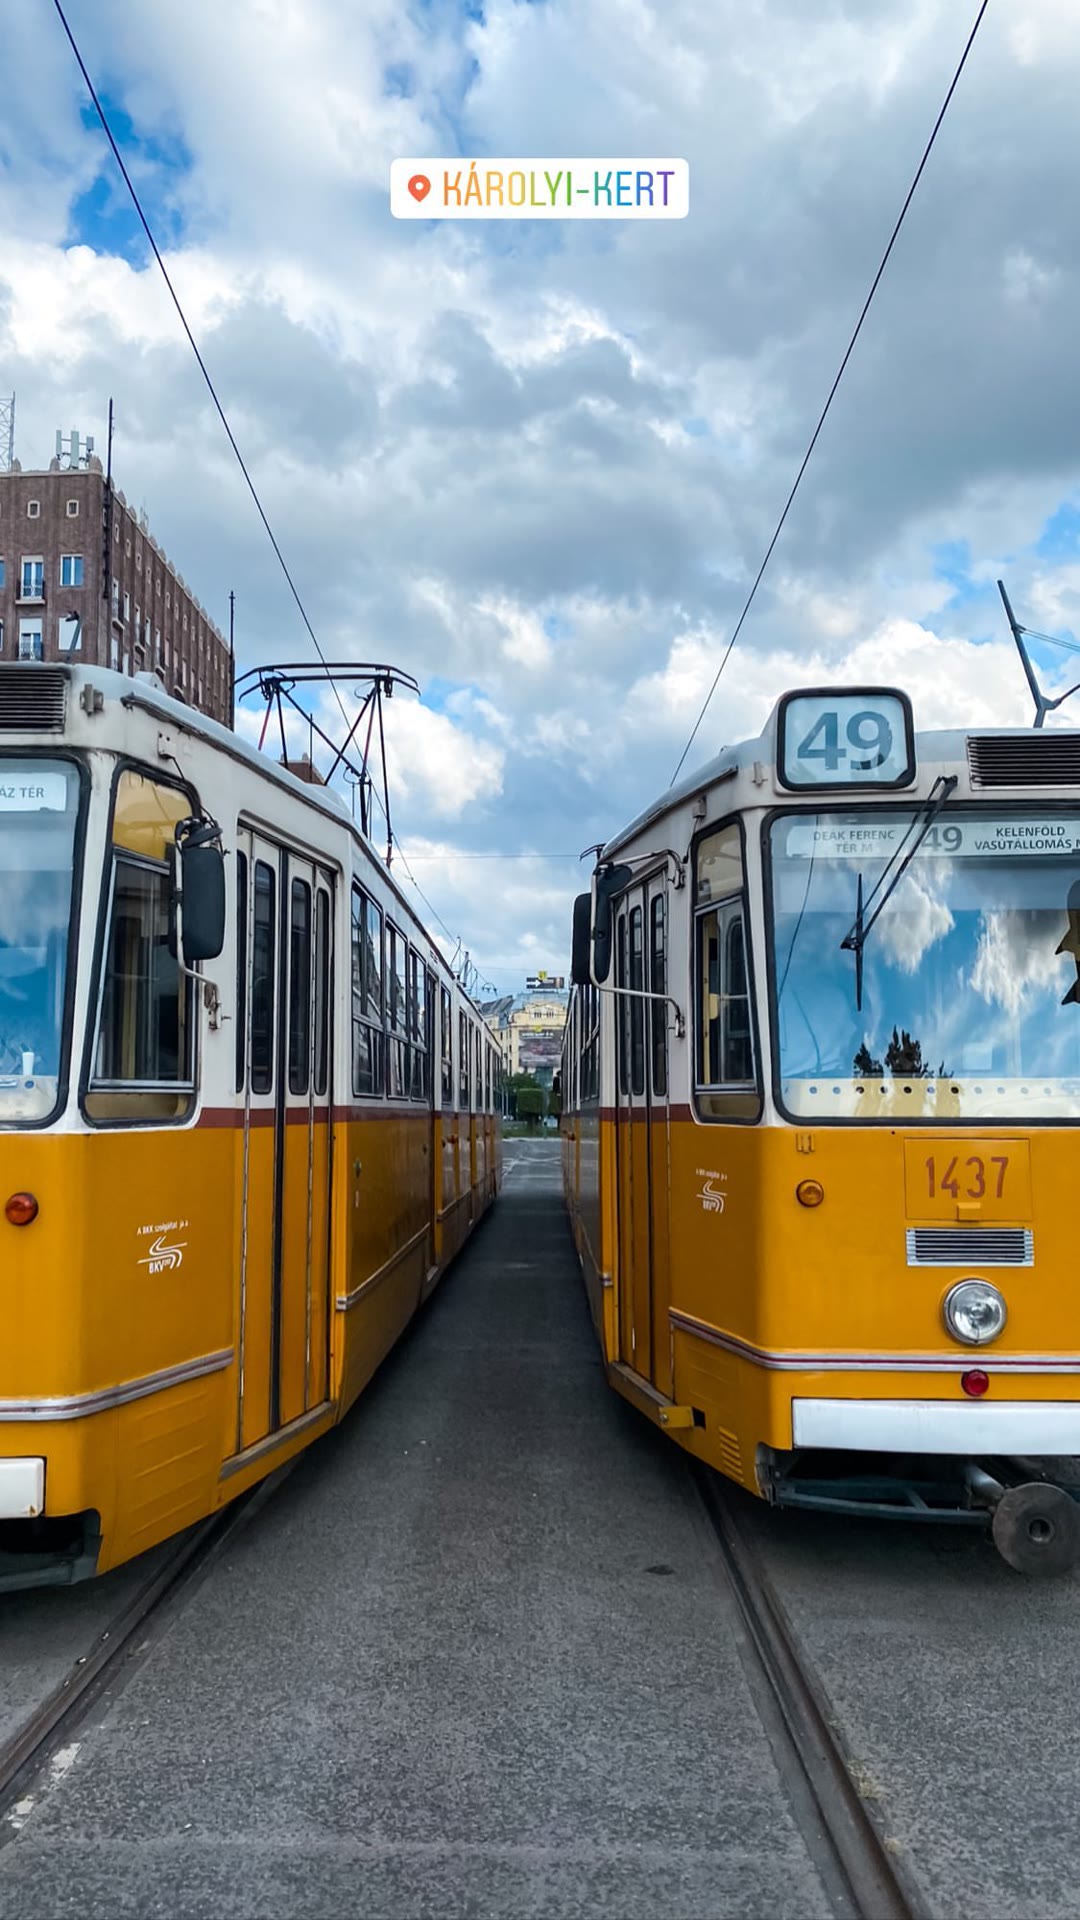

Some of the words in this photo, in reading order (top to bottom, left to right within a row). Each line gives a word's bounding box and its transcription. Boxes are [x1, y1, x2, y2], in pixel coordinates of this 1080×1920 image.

[797, 711, 893, 771] 49
[19, 784, 44, 798] TÉR
[849, 829, 895, 840] FERENC
[996, 826, 1065, 837] KELENFÖLD
[920, 826, 963, 852] 49
[974, 837, 1072, 850] VASÚTÁLLOMÁS
[836, 841, 857, 853] TÉR
[926, 1156, 1009, 1198] 1437
